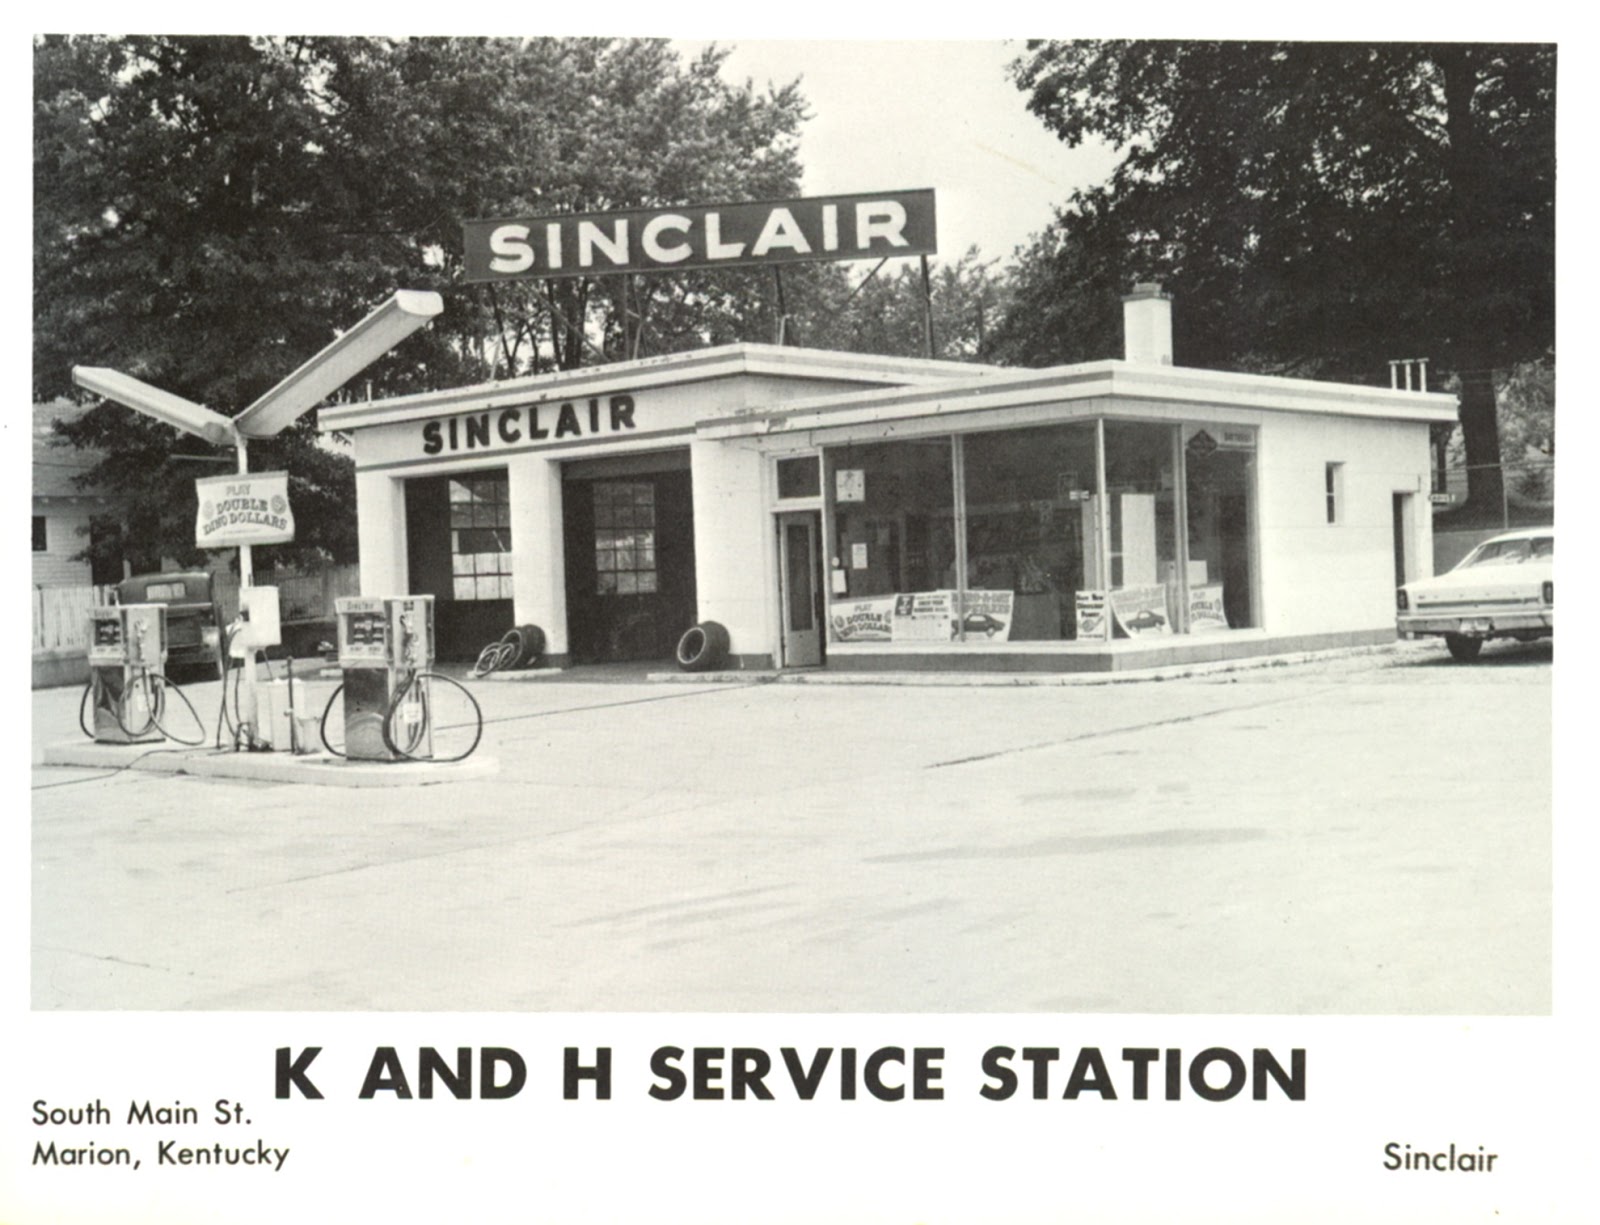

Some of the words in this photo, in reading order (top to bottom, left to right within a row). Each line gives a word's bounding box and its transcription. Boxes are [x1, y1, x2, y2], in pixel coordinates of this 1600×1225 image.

[488, 200, 911, 274] SINCLAIR
[422, 395, 637, 456] SINCLAIR
[226, 484, 251, 496] PLAY
[216, 498, 268, 515] DOUBLE
[203, 515, 228, 536] DINO
[229, 511, 288, 530] DOLLARS
[846, 612, 882, 625] DOUBLE
